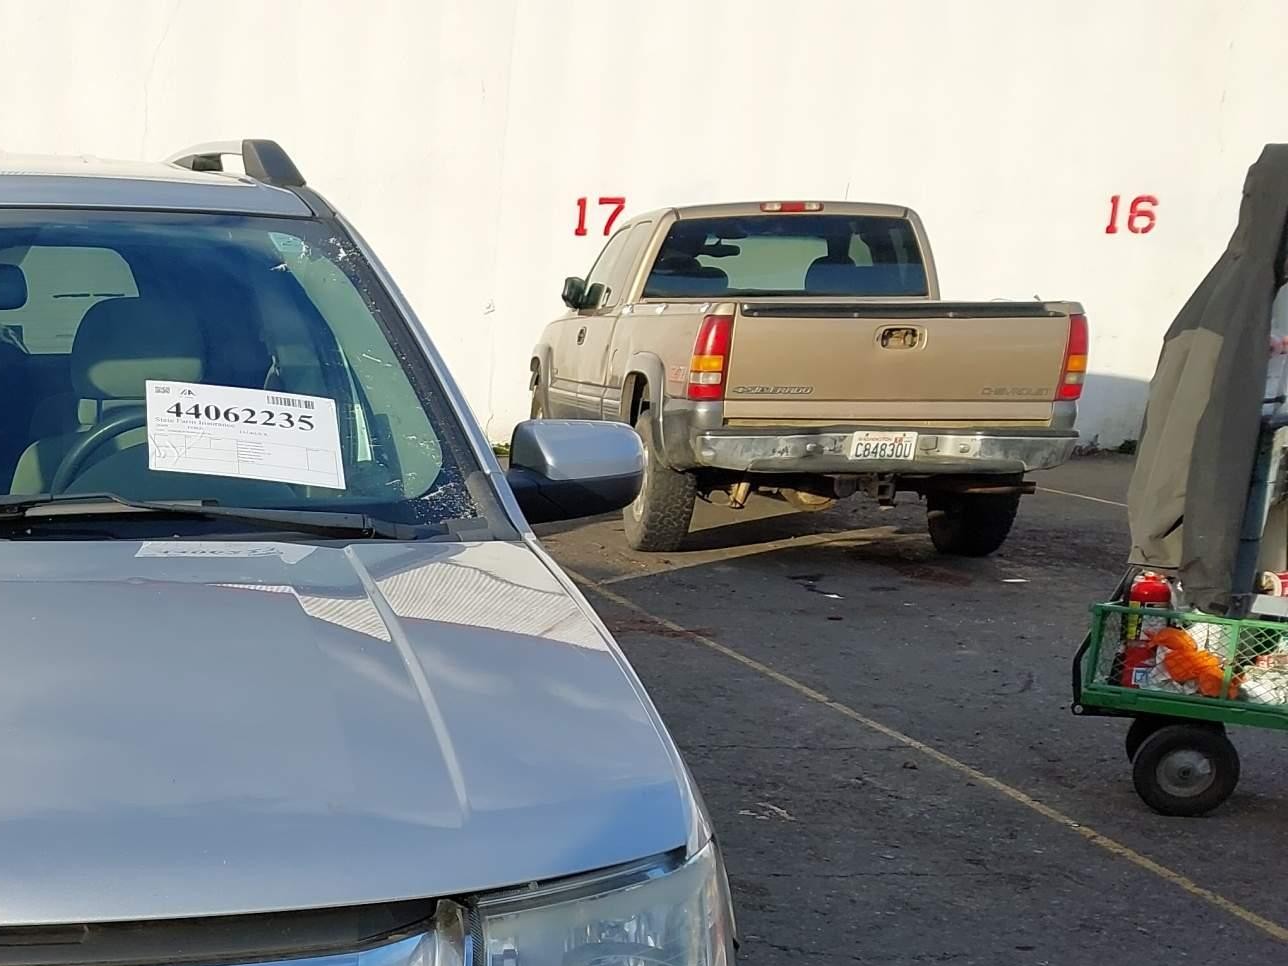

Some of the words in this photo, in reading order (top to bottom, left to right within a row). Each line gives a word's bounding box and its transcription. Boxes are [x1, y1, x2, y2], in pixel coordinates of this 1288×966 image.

[574, 197, 625, 236] 17
[1105, 194, 1159, 234] 16
[166, 401, 316, 432] 44062235
